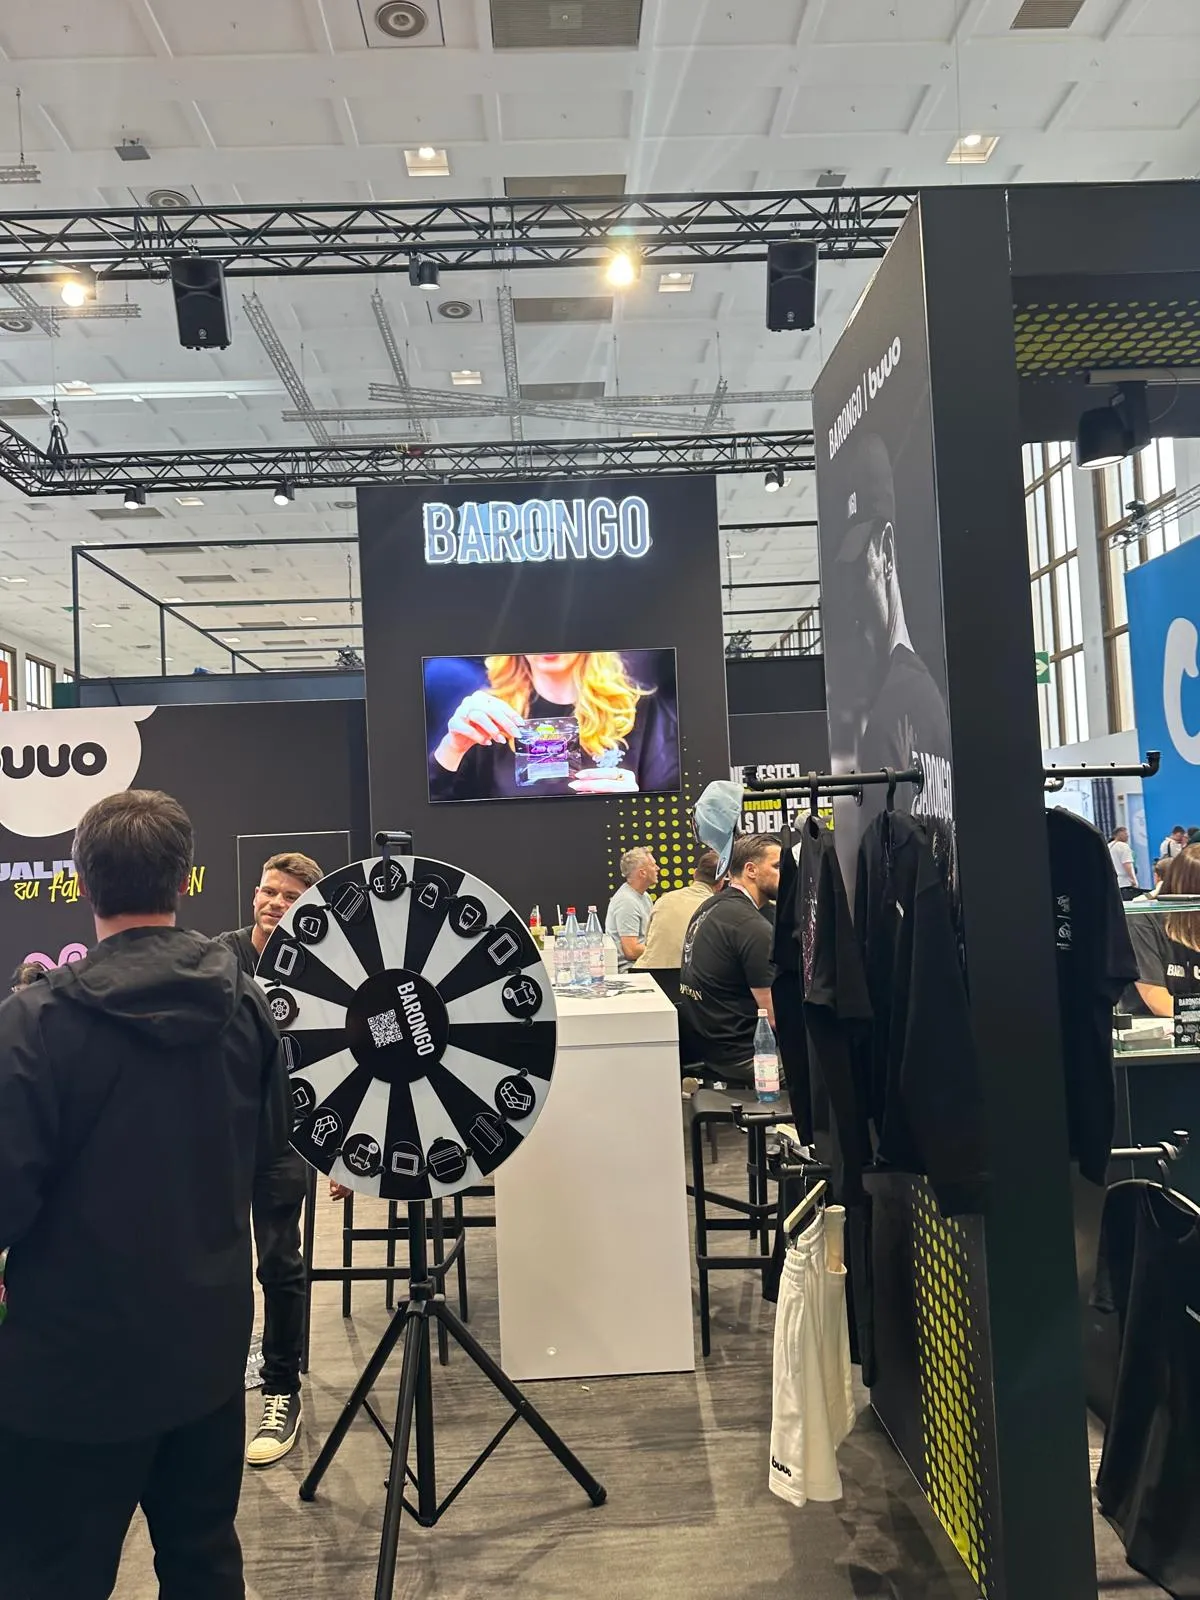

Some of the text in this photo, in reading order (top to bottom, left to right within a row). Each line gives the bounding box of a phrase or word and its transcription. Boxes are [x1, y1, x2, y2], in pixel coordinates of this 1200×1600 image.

[828, 336, 901, 461] BARONGO buuo
[423, 496, 652, 564] BARONGO
[0, 741, 108, 780] uuo
[911, 750, 953, 824] ARONGO
[396, 980, 435, 1056] BARONGO
